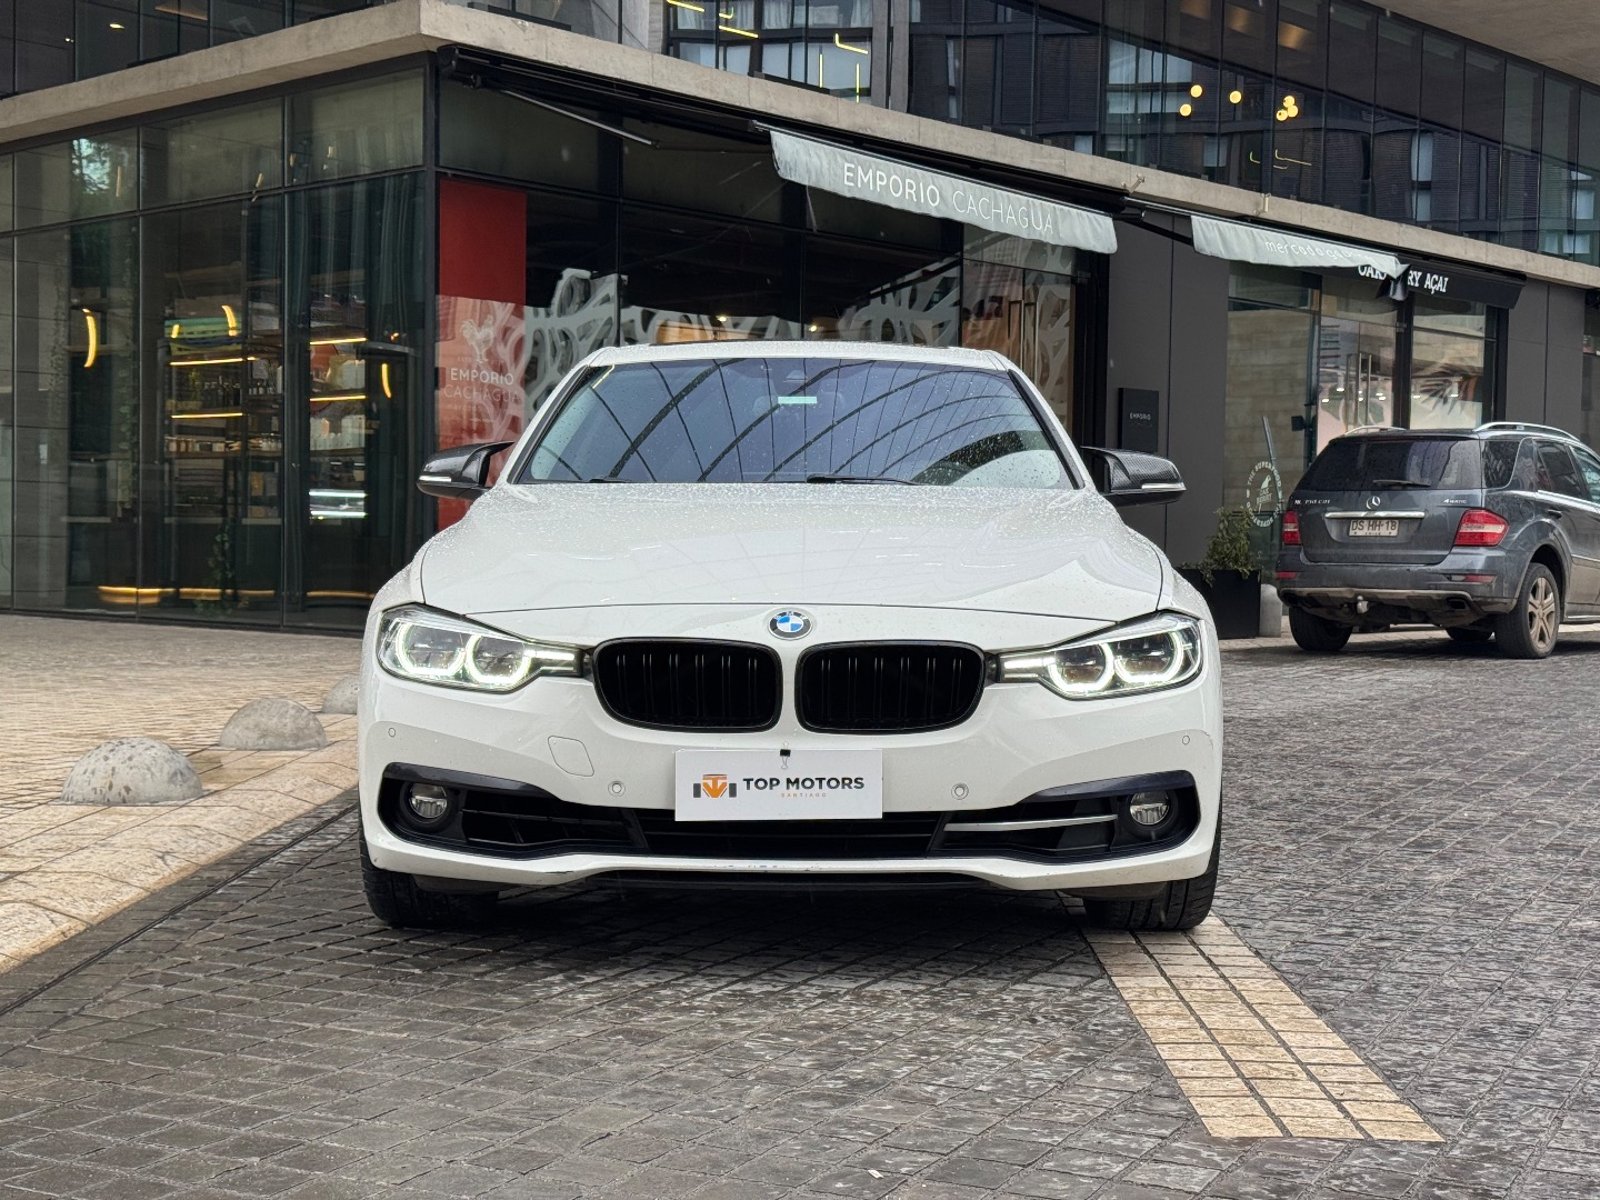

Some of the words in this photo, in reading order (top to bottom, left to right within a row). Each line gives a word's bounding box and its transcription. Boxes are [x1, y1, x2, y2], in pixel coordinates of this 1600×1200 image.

[843, 162, 940, 207] EMPORIO
[952, 190, 1054, 234] CACHAGUA
[1265, 241, 1325, 256] mercado
[1424, 273, 1449, 295] AÇAI
[450, 367, 514, 386] EMPORIO
[1351, 520, 1365, 531] DS
[743, 777, 780, 791] TOP
[786, 777, 865, 790] MOTORS
